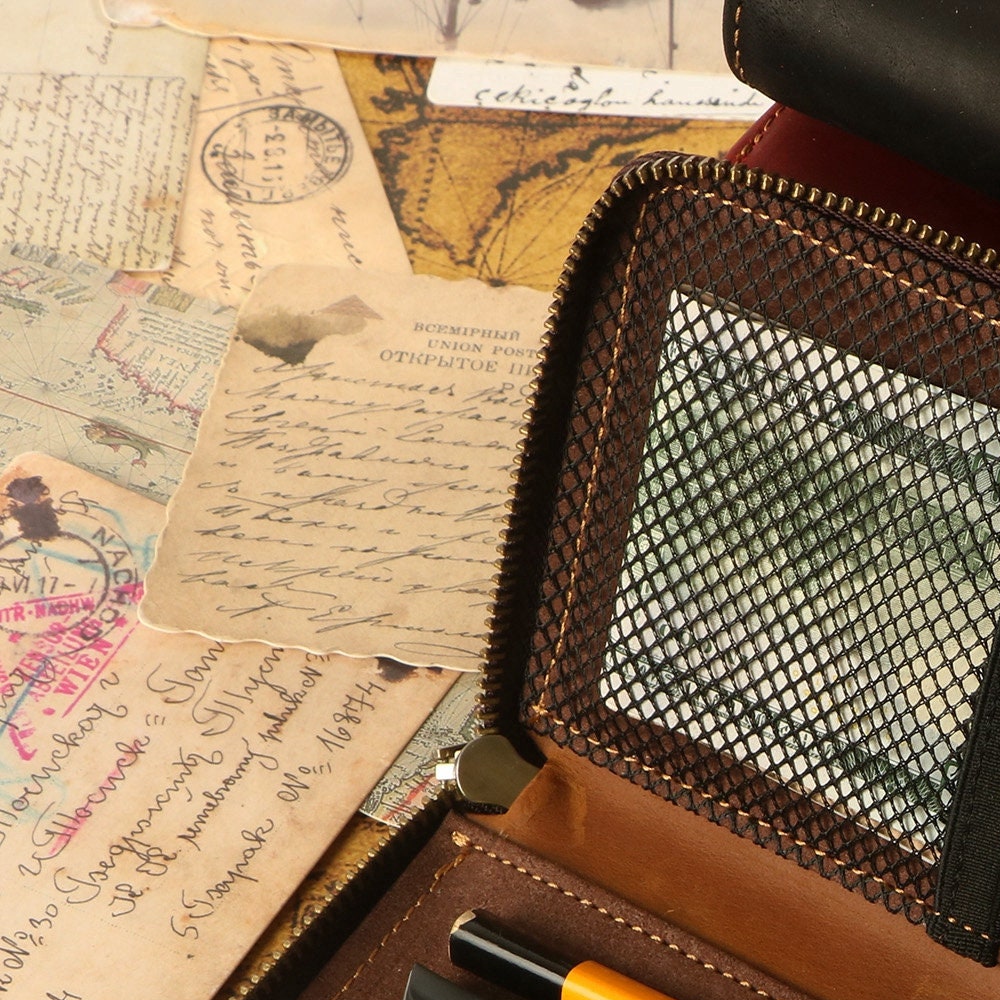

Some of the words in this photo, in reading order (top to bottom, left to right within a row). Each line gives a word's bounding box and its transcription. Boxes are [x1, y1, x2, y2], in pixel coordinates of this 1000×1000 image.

[427, 338, 483, 354] UNION
[379, 349, 499, 374] ОТКРЫТОЕ
[53, 637, 115, 698] WIEN
